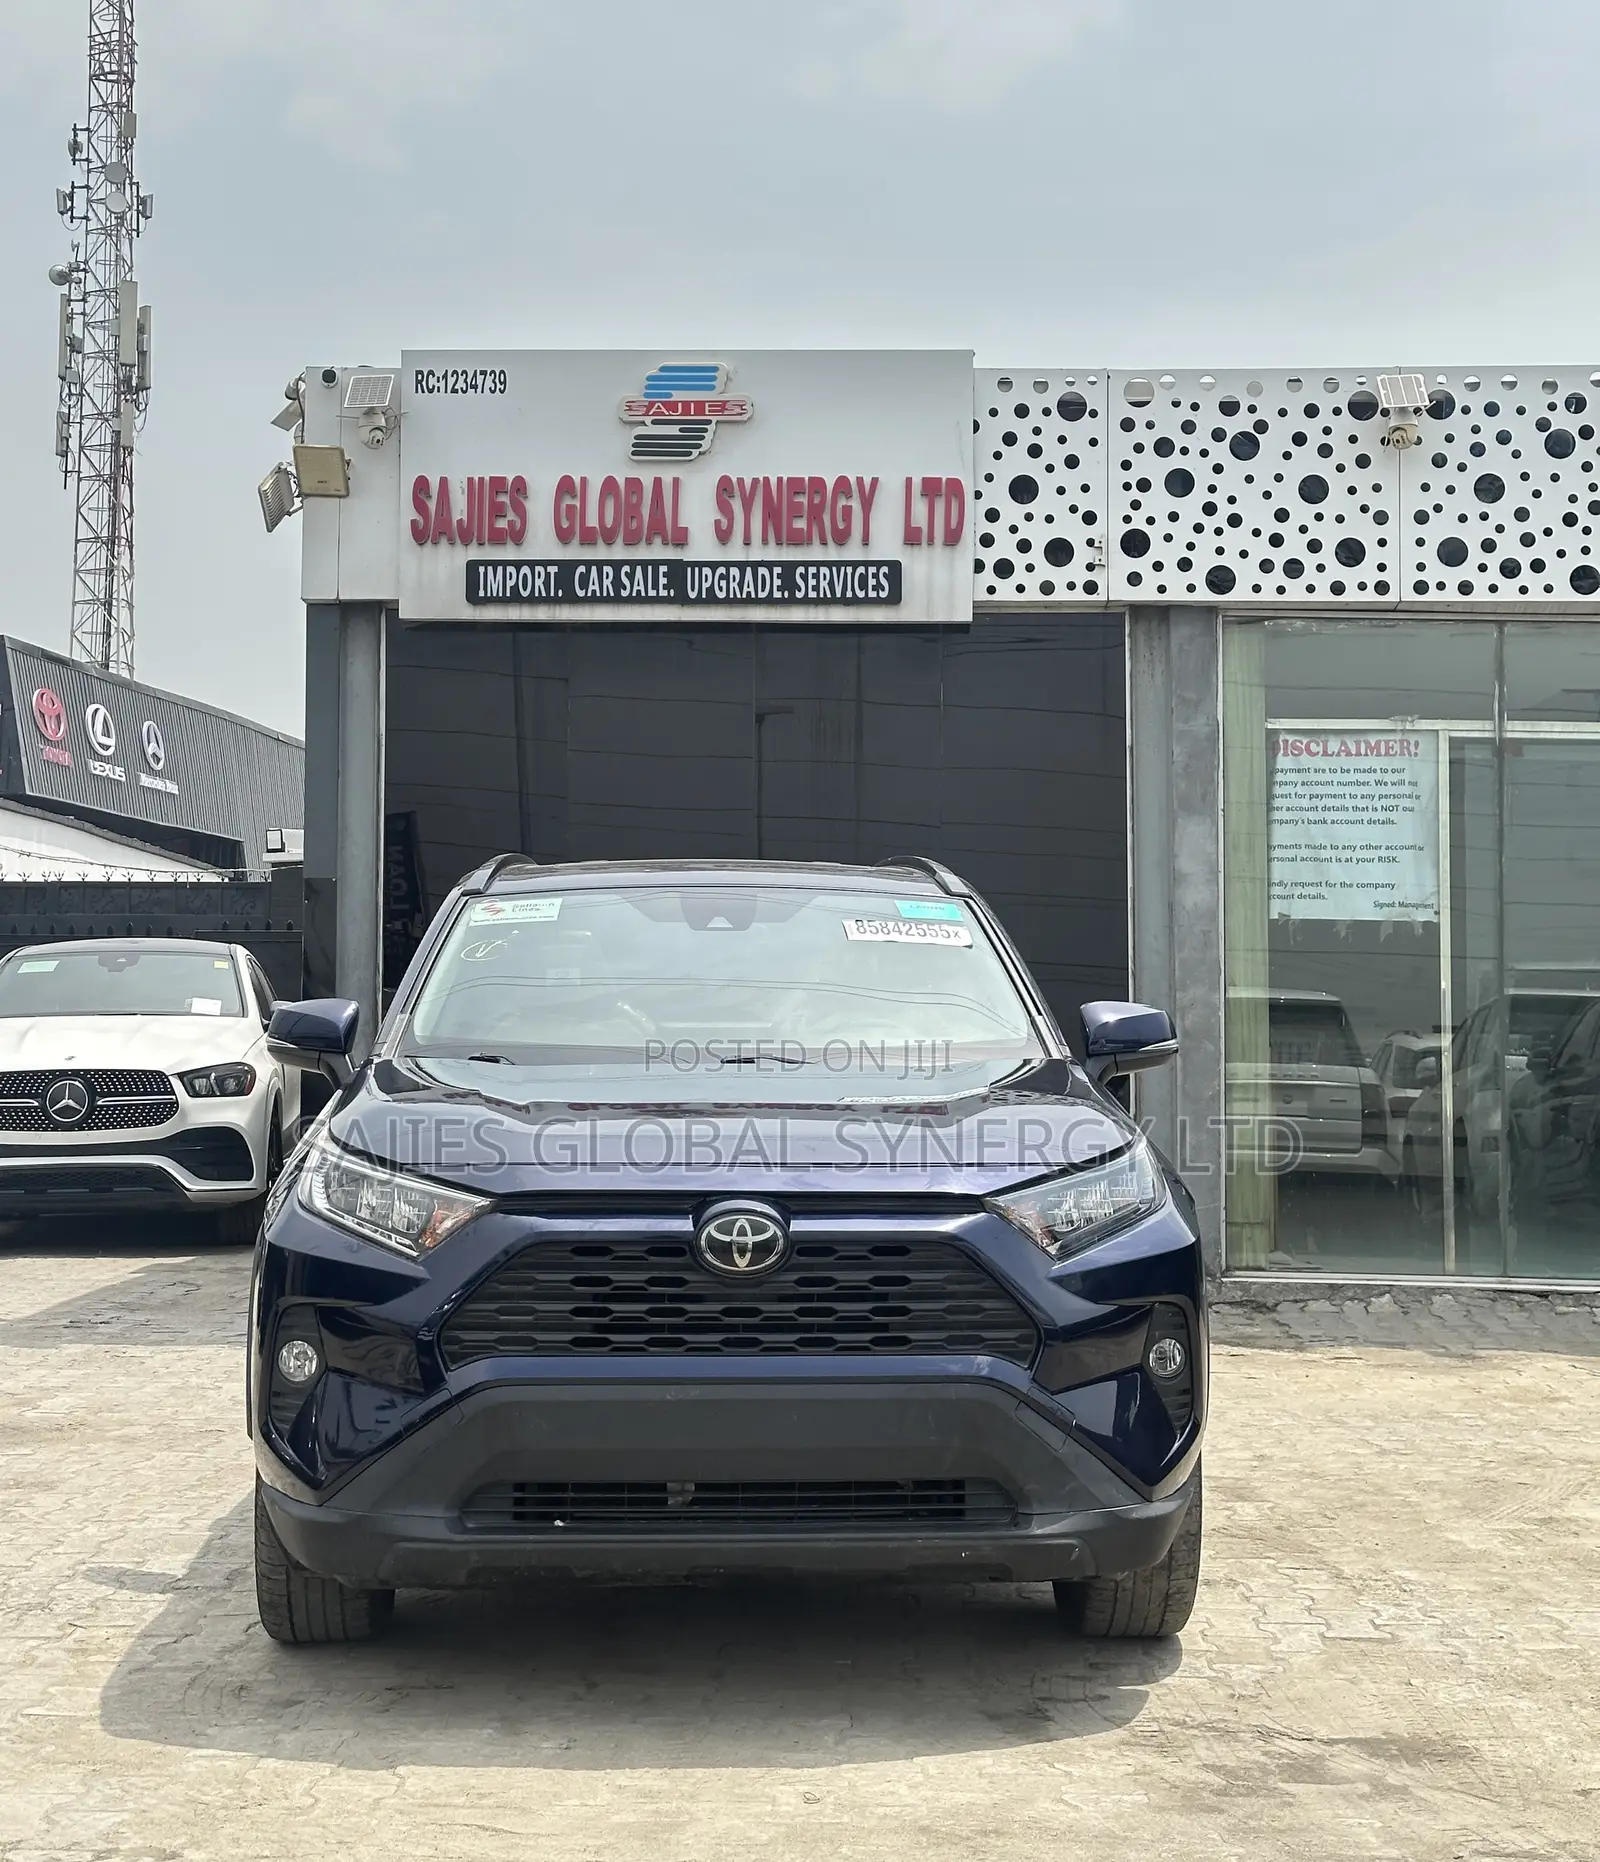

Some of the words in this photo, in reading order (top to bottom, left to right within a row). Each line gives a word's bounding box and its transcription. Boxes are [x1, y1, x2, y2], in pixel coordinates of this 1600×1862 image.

[414, 369, 507, 394] RC:1234739
[624, 400, 748, 416] SAJIES
[410, 474, 529, 545] SAJIES
[553, 474, 690, 545] GLOBAL
[714, 474, 880, 545] SYNERGY
[903, 476, 967, 545] LTD
[478, 565, 563, 598] IMPORT.
[574, 565, 615, 597] CAR
[620, 565, 675, 597] SALE.
[686, 566, 789, 599] UPGRADE.
[794, 566, 890, 598] SERVICES
[88, 760, 126, 782] LEXUS
[1274, 767, 1311, 776] payment
[1329, 766, 1338, 774] to
[1340, 766, 1351, 774] be
[1353, 766, 1378, 774] made
[1380, 766, 1389, 774] to
[1336, 779, 1372, 787] number.
[1374, 779, 1388, 787] We
[1390, 779, 1406, 787] will
[1309, 792, 1347, 801] payment
[1360, 793, 1376, 801] any
[1378, 792, 1414, 801] personal
[1285, 804, 1319, 812] account
[1321, 804, 1350, 812] details
[1352, 804, 1369, 812] that
[1371, 804, 1378, 812] is
[1380, 804, 1400, 812] NOT
[1307, 817, 1328, 825] bank
[1366, 817, 1397, 825] details.
[1304, 843, 1328, 851] made
[1330, 843, 1339, 851] to
[1359, 843, 1382, 851] other
[1335, 855, 1342, 863] is
[1355, 857, 1375, 865] your
[1377, 855, 1400, 863] RISK.
[1290, 881, 1323, 889] request
[1325, 880, 1337, 888] for
[1356, 882, 1396, 891] company
[1297, 892, 1328, 900] details.
